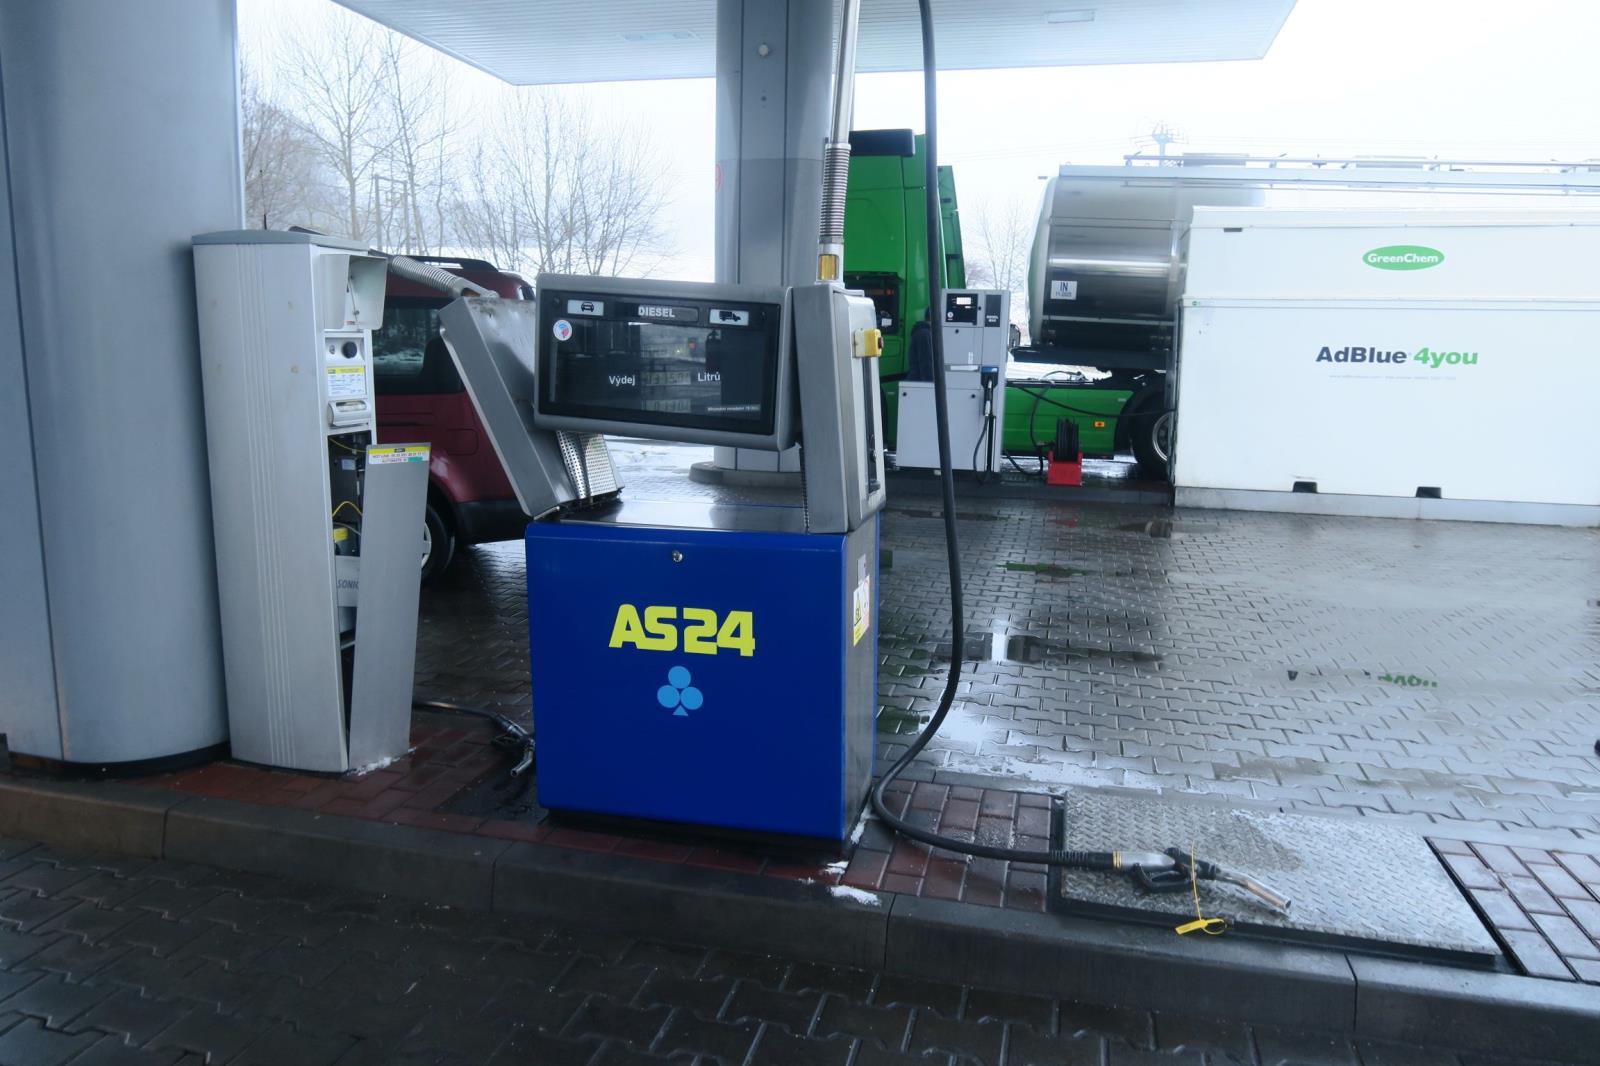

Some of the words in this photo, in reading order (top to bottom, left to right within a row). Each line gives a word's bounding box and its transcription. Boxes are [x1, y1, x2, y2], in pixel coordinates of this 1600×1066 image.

[1367, 253, 1439, 263] GreenChem
[638, 305, 676, 318] DIESEL
[1316, 346, 1407, 364] AdBlue
[1413, 347, 1479, 369] 4you
[608, 374, 636, 387] Výdej
[608, 603, 756, 657] AS24
